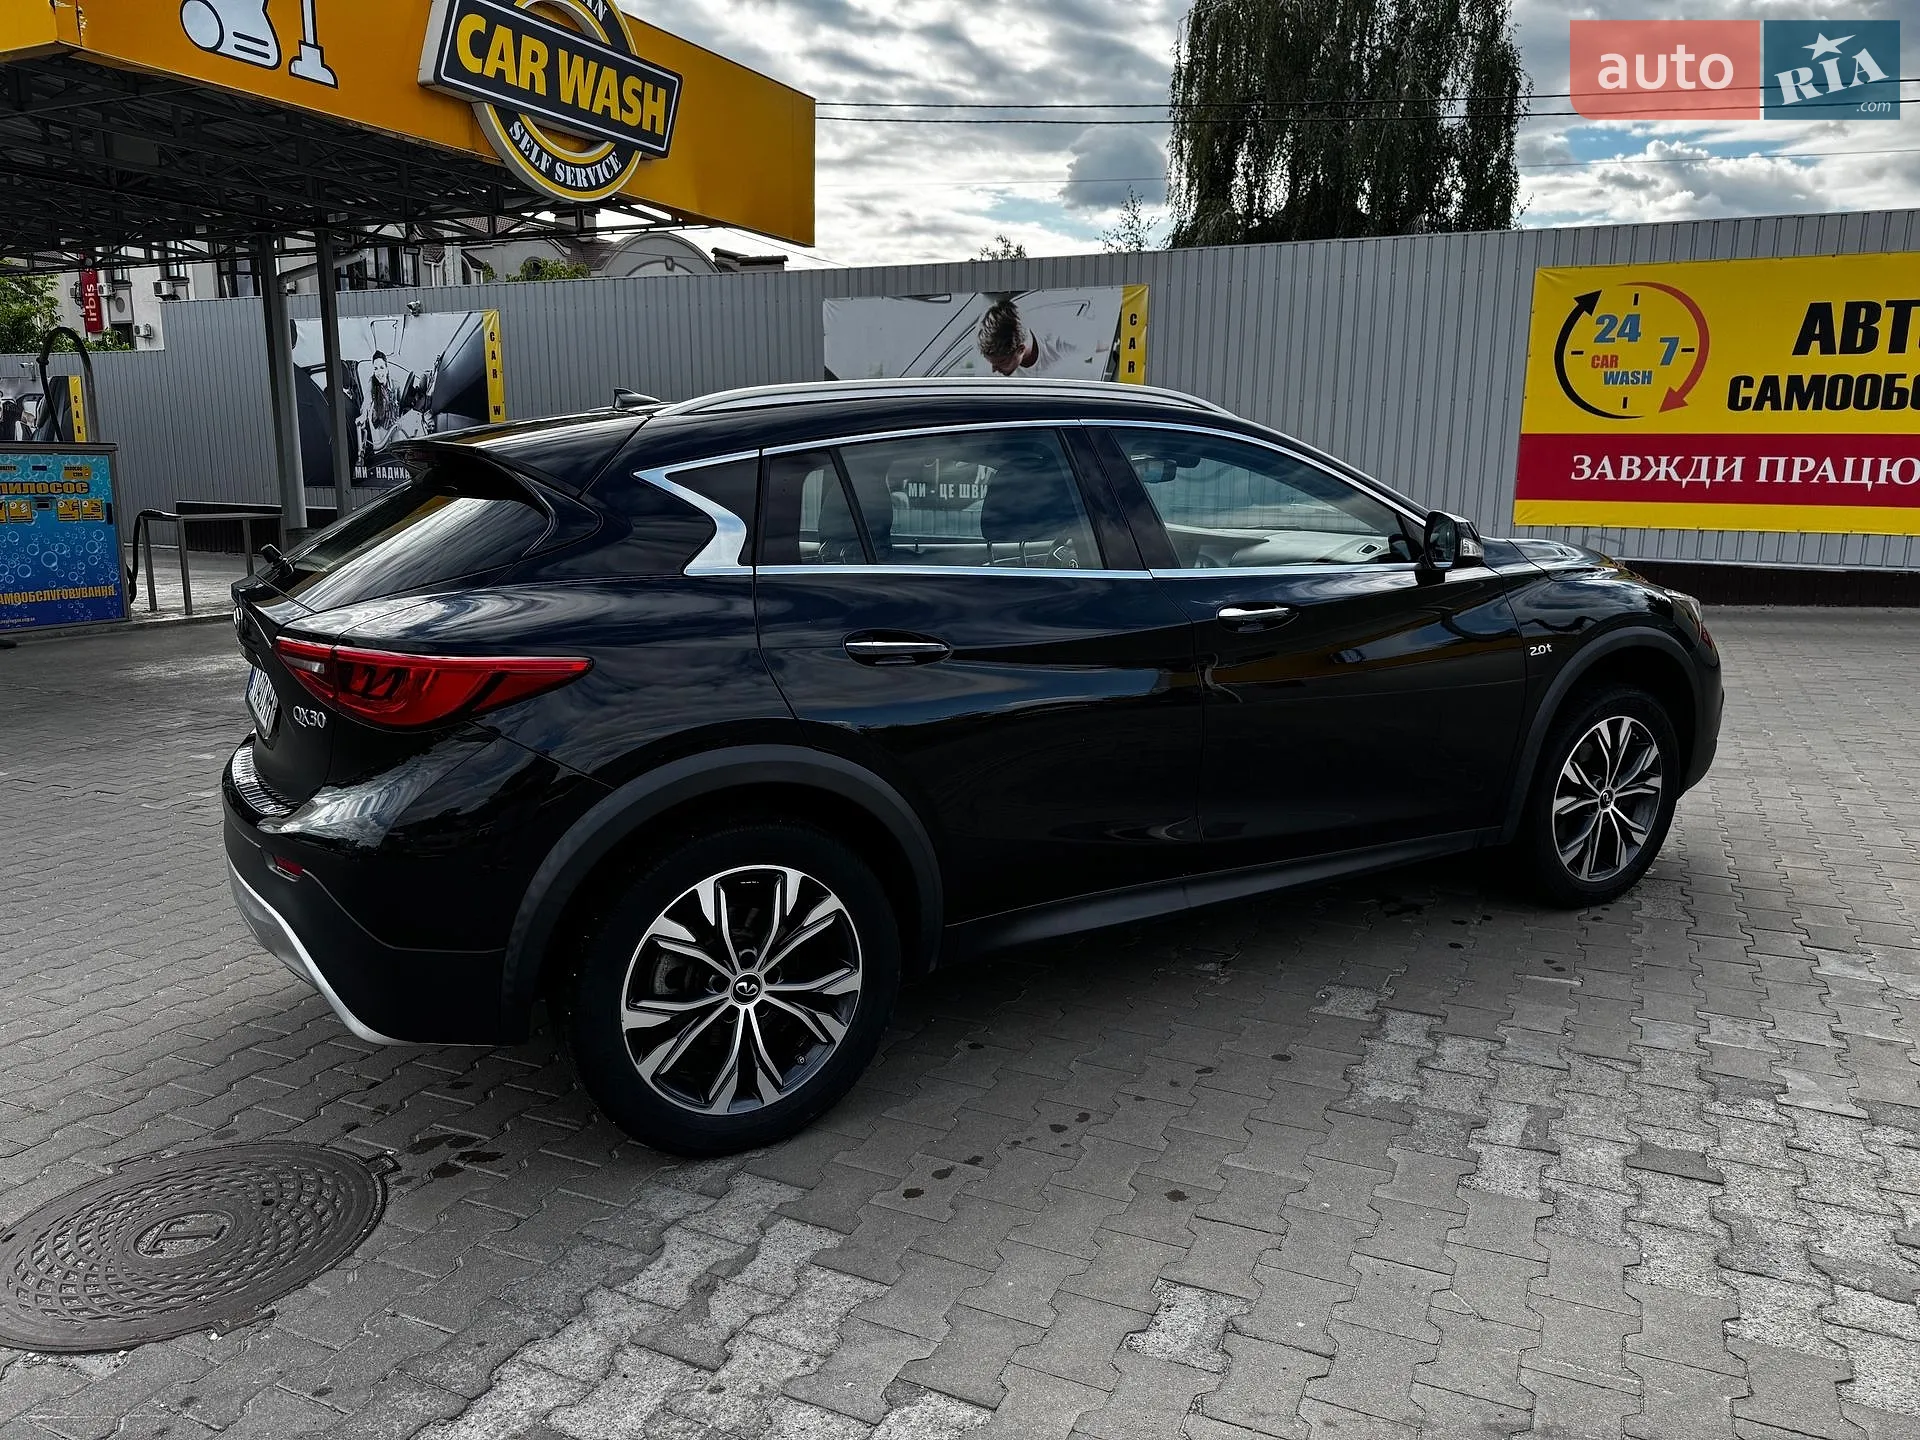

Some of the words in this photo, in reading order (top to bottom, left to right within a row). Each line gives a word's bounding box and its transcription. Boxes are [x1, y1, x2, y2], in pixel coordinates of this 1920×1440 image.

[456, 13, 549, 97] CAR
[558, 47, 667, 136] WASH
[508, 120, 550, 173] SELF
[553, 150, 622, 188] SERVICE
[85, 284, 97, 322] irbis
[1127, 313, 1137, 373] CAR
[1593, 313, 1641, 343] 24
[1791, 299, 1920, 356] АВТ
[489, 331, 498, 379] CAR
[1590, 354, 1619, 369] CAR
[1659, 336, 1680, 366] 7
[1603, 370, 1653, 385] WASH
[355, 466, 368, 479] МИ
[1570, 454, 1746, 489] ЗАВЖДИ
[1758, 456, 1920, 492] ПРАЦЮ
[908, 483, 926, 497] МИ
[940, 483, 954, 500] ЦЕ
[293, 705, 326, 729] QX30
